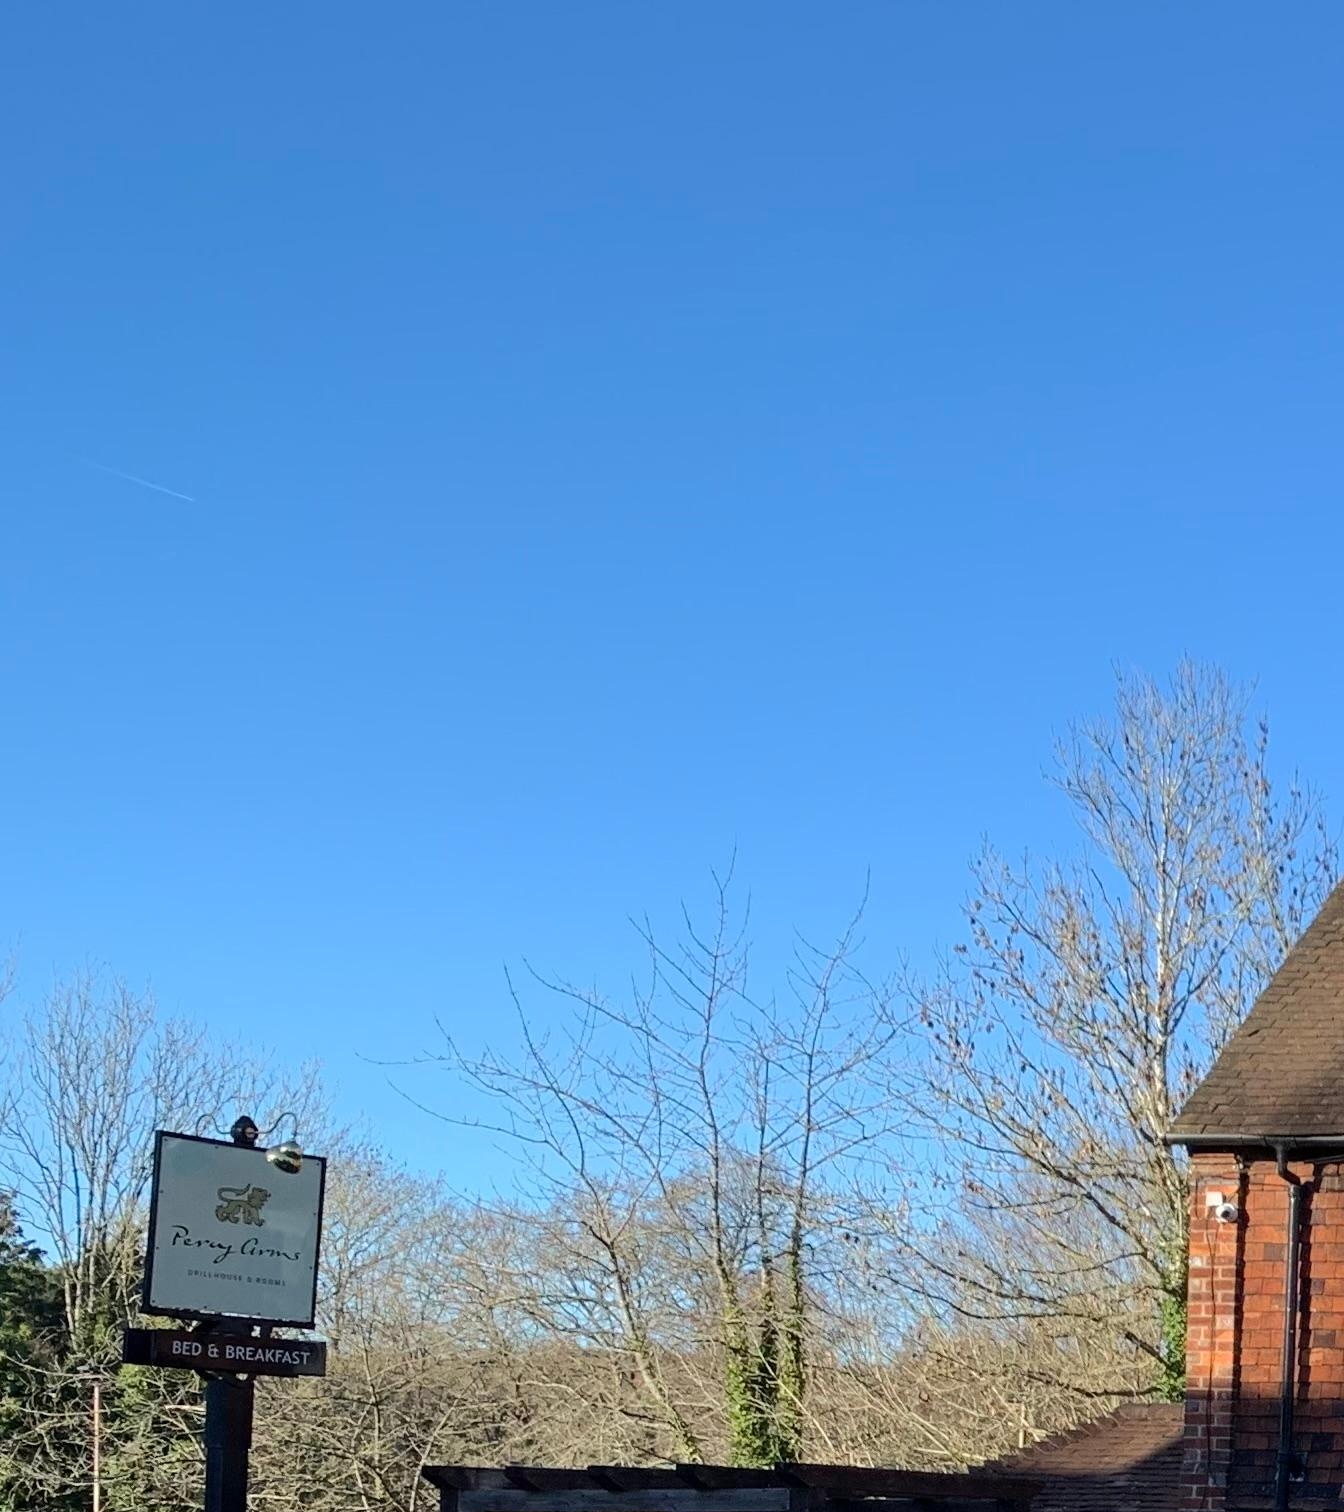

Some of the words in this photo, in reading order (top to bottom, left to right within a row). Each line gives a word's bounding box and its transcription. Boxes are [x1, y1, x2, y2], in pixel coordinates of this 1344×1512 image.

[171, 1225, 237, 1264] Percy
[240, 1238, 301, 1261] Arms
[171, 1340, 203, 1356] BED
[207, 1343, 220, 1358] &
[225, 1344, 311, 1365] BREAKFAST
